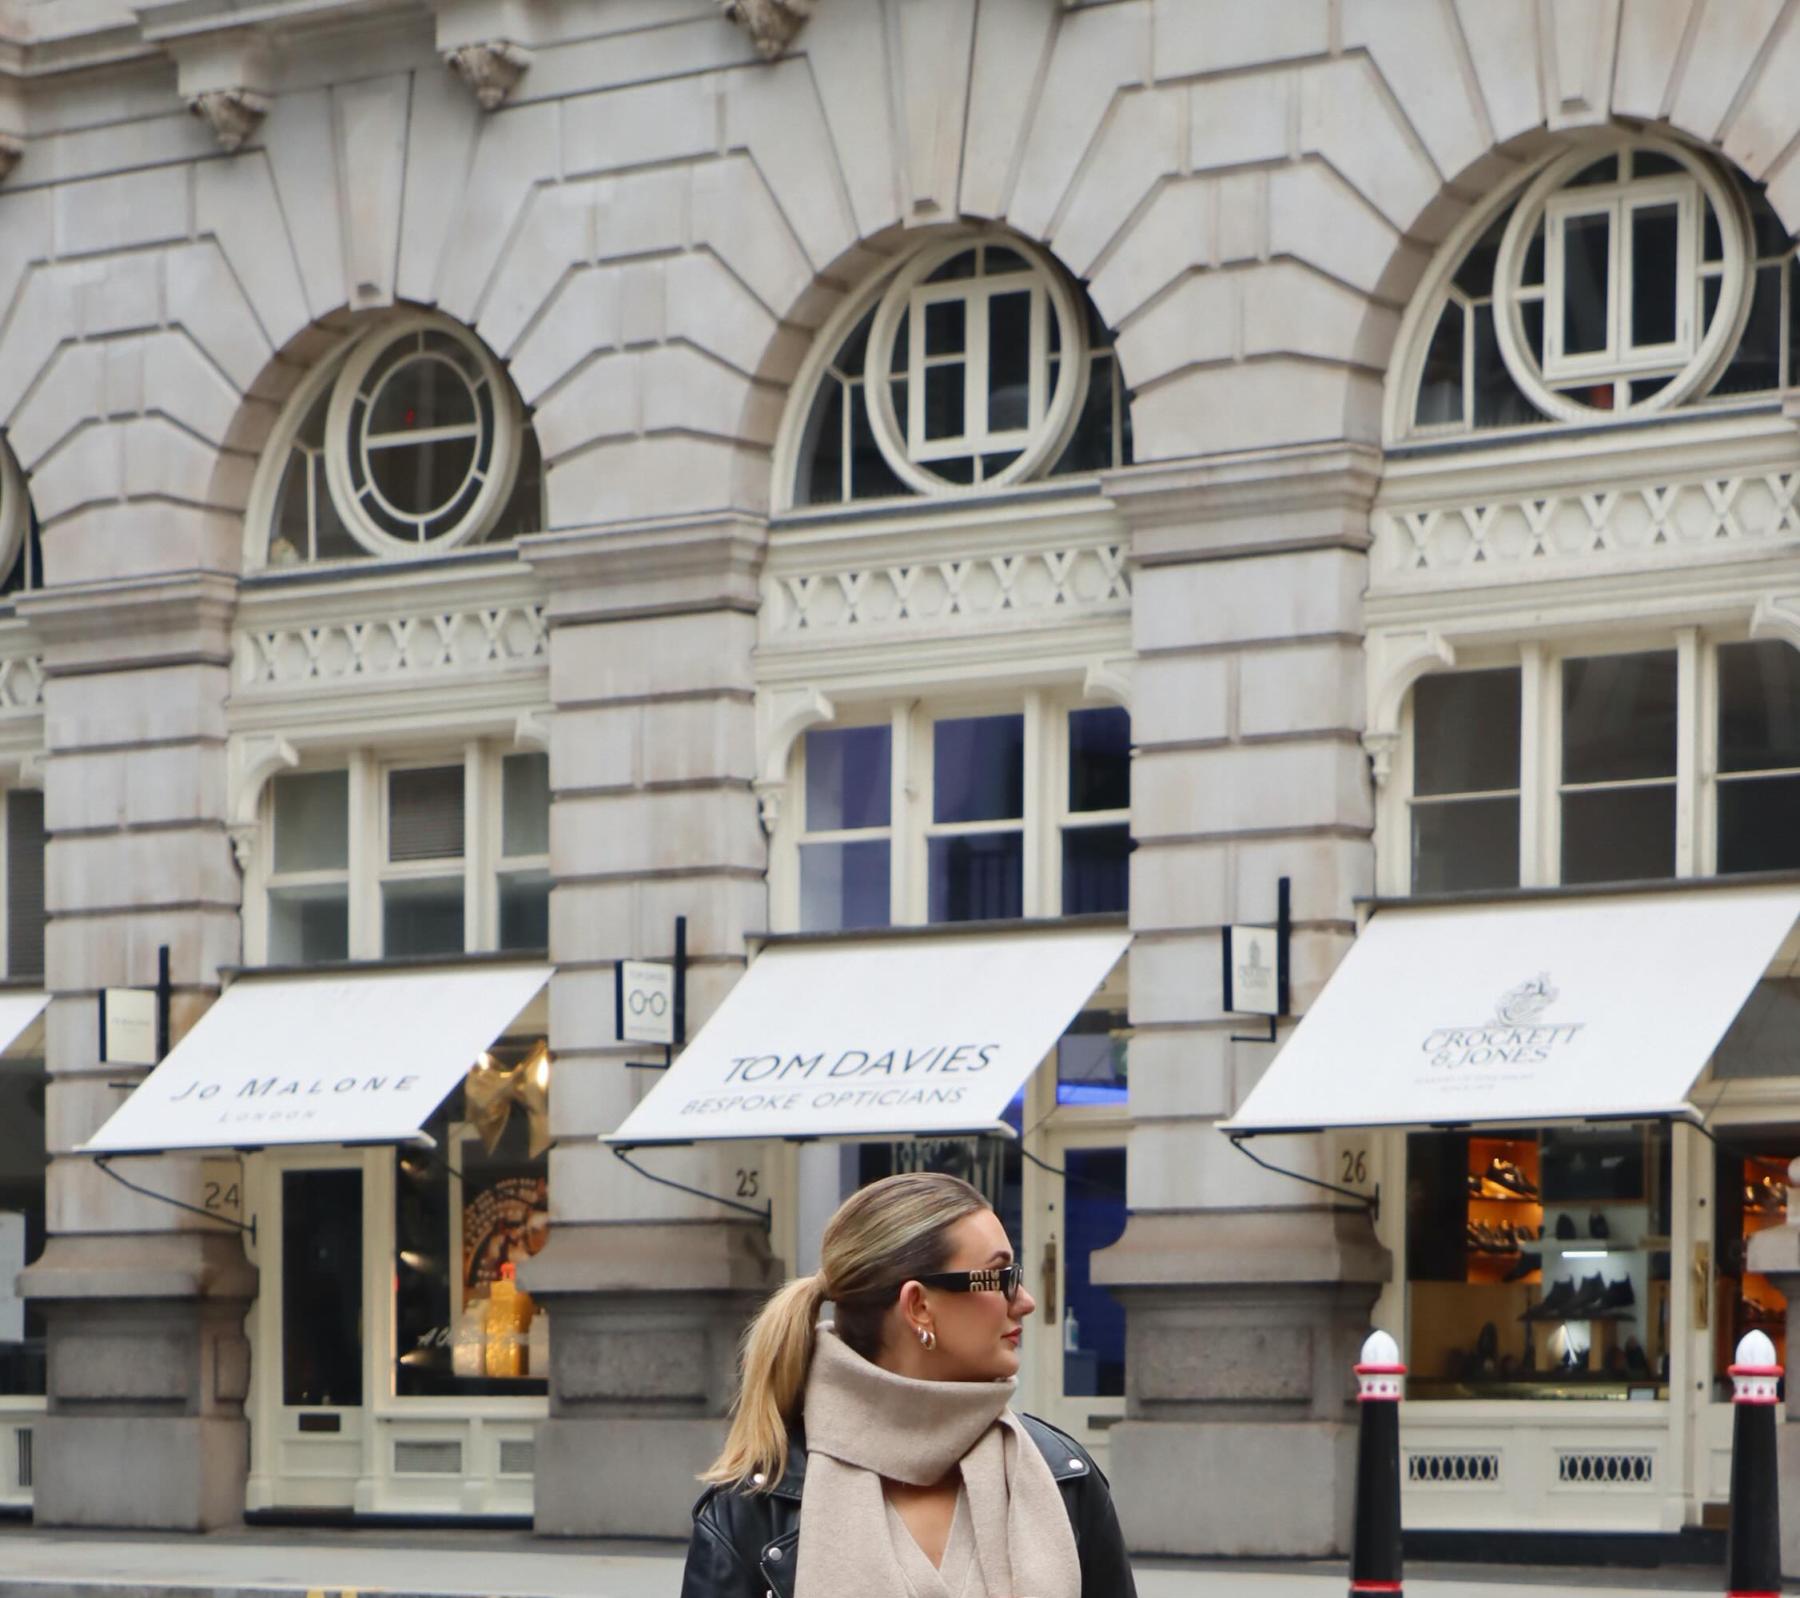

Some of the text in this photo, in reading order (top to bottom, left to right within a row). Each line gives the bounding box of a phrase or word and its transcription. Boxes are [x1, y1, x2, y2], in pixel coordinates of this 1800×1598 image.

[1421, 1025, 1584, 1052] CROCKETT
[723, 1044, 1000, 1083] TOM DAVIES
[236, 1075, 420, 1098] MALONE
[680, 1087, 967, 1115] BESPOKE OPTICIANS
[1342, 1150, 1367, 1183] 26
[204, 1181, 240, 1208] 24
[735, 1168, 759, 1197] 25
[969, 1281, 1000, 1292] miu
